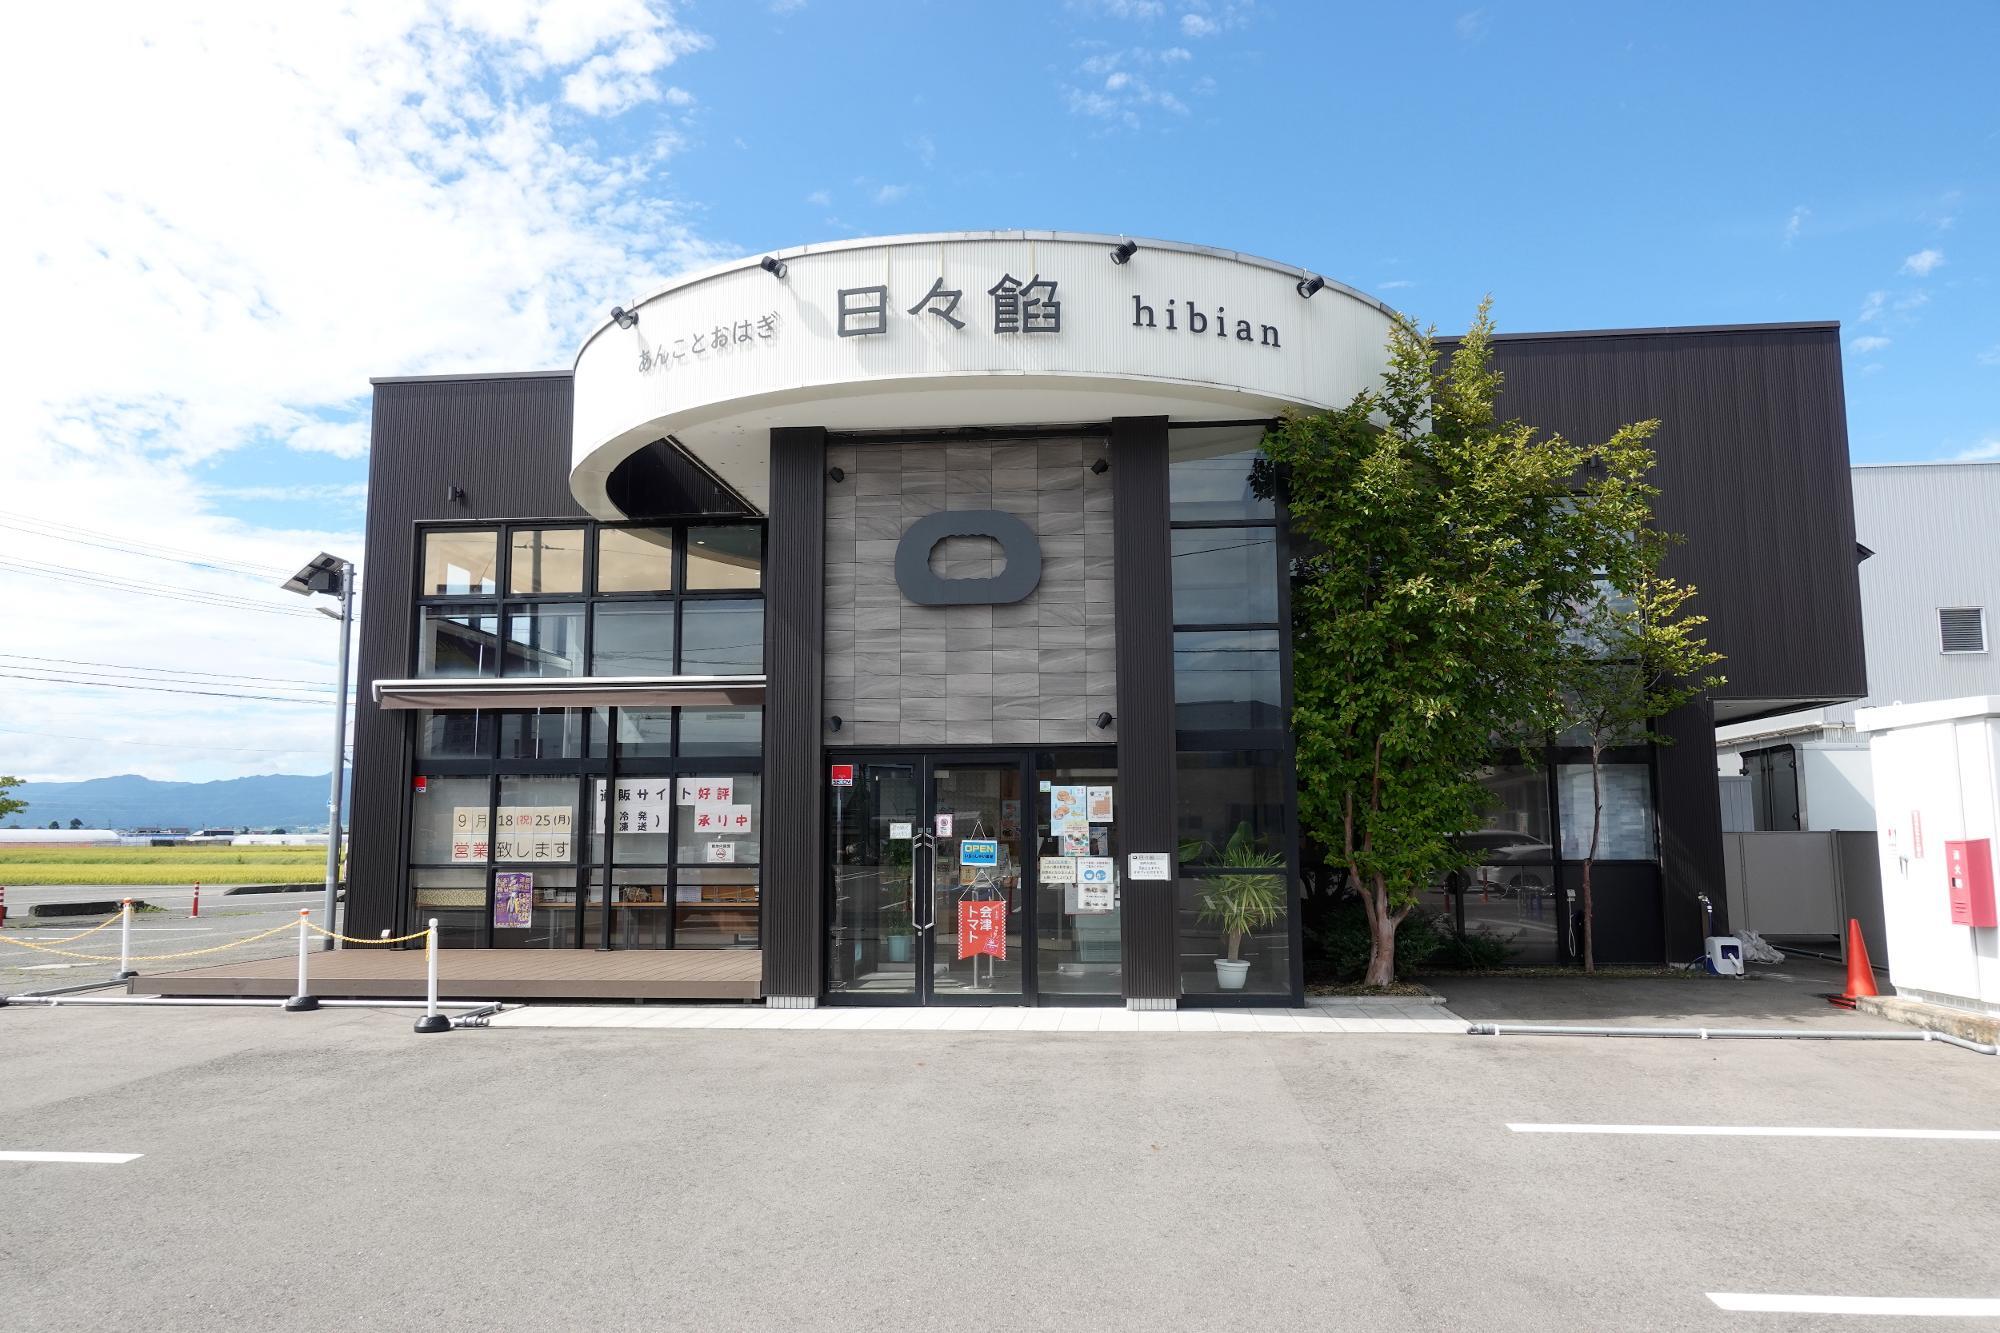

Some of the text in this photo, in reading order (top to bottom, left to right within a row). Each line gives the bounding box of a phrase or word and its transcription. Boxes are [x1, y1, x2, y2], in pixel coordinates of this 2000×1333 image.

[837, 273, 1061, 338] 日々餡
[1132, 295, 1282, 348] hibian
[638, 310, 779, 373] あんことおはぎ
[697, 814, 749, 827] 承り中
[454, 841, 570, 859] 営業致します
[964, 844, 994, 853] OPEN
[967, 905, 979, 944] トマト
[979, 905, 993, 932] 会津
